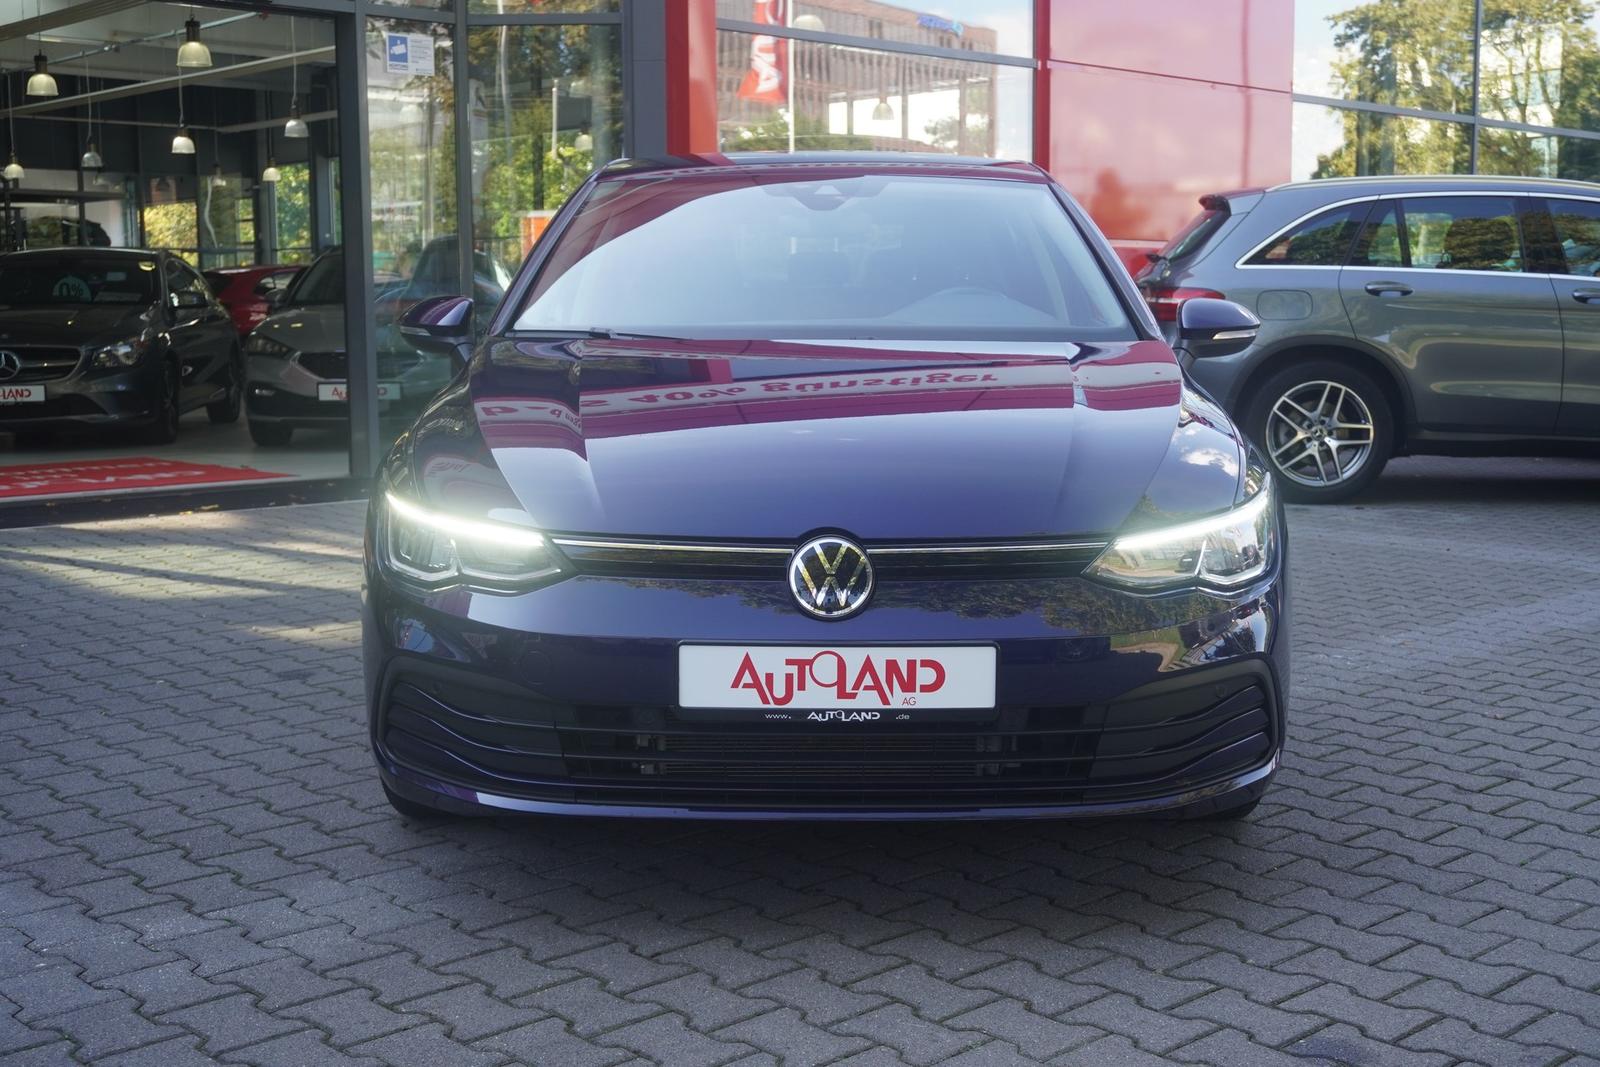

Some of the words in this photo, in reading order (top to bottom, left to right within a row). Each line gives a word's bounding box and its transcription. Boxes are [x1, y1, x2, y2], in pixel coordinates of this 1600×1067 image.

[730, 650, 946, 706] AUTOLAND
[902, 697, 917, 706] AG
[807, 710, 880, 722] AUTOLAND
